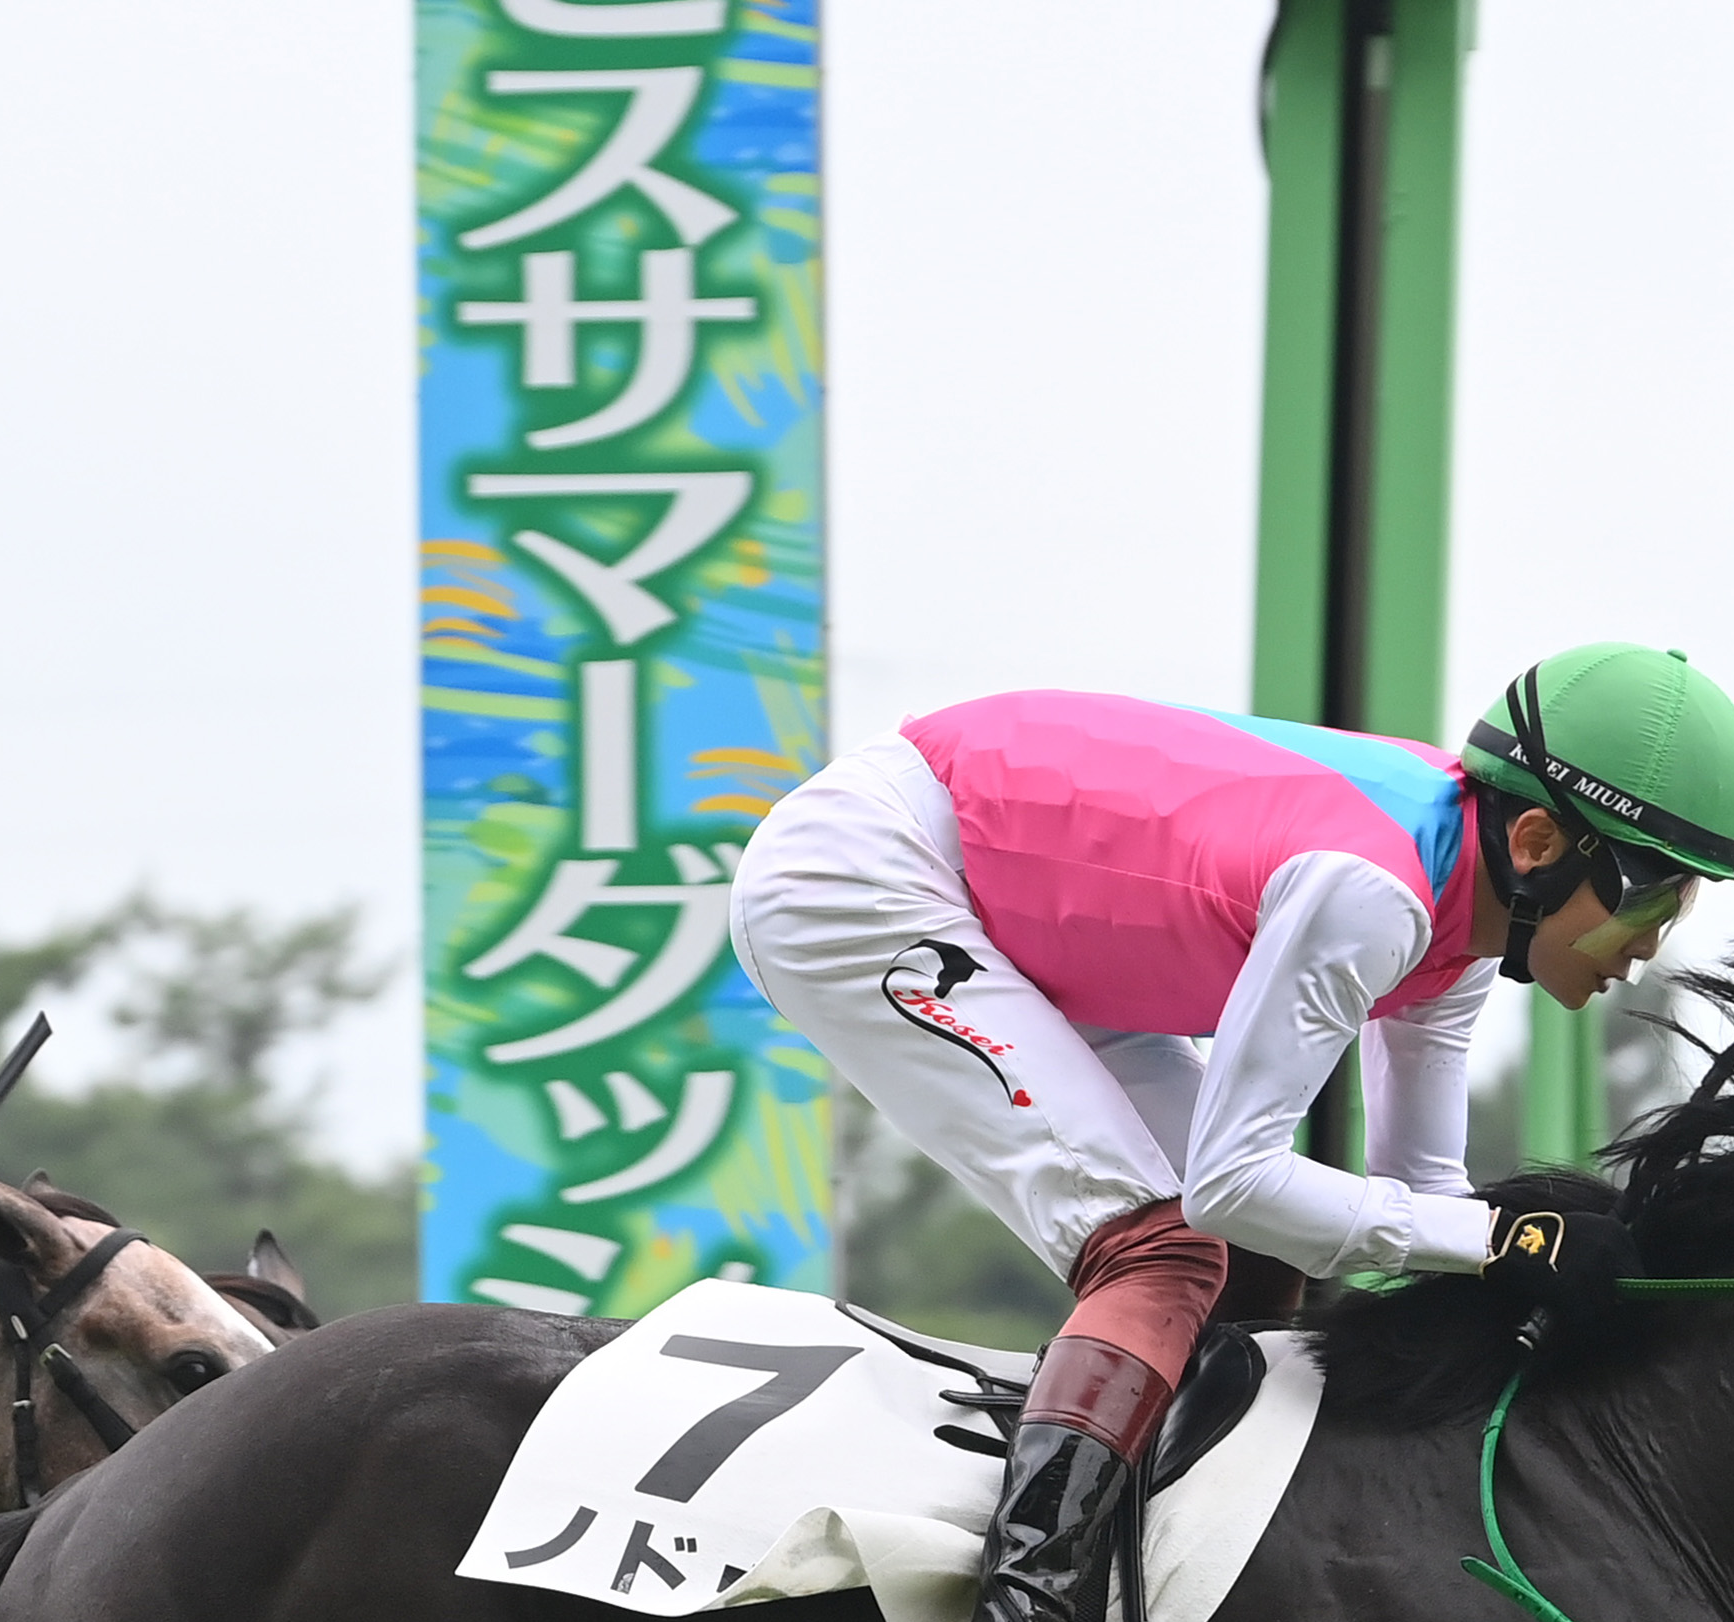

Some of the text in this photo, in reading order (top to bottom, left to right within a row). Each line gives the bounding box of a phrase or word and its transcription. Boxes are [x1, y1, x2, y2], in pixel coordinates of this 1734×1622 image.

[457, 0, 758, 1316] スサマーダッ
[1508, 742, 1645, 821] KEI MIURA
[892, 988, 1015, 1057] Kosei
[635, 1334, 866, 1504] 7
[503, 1505, 751, 1594] ノド
